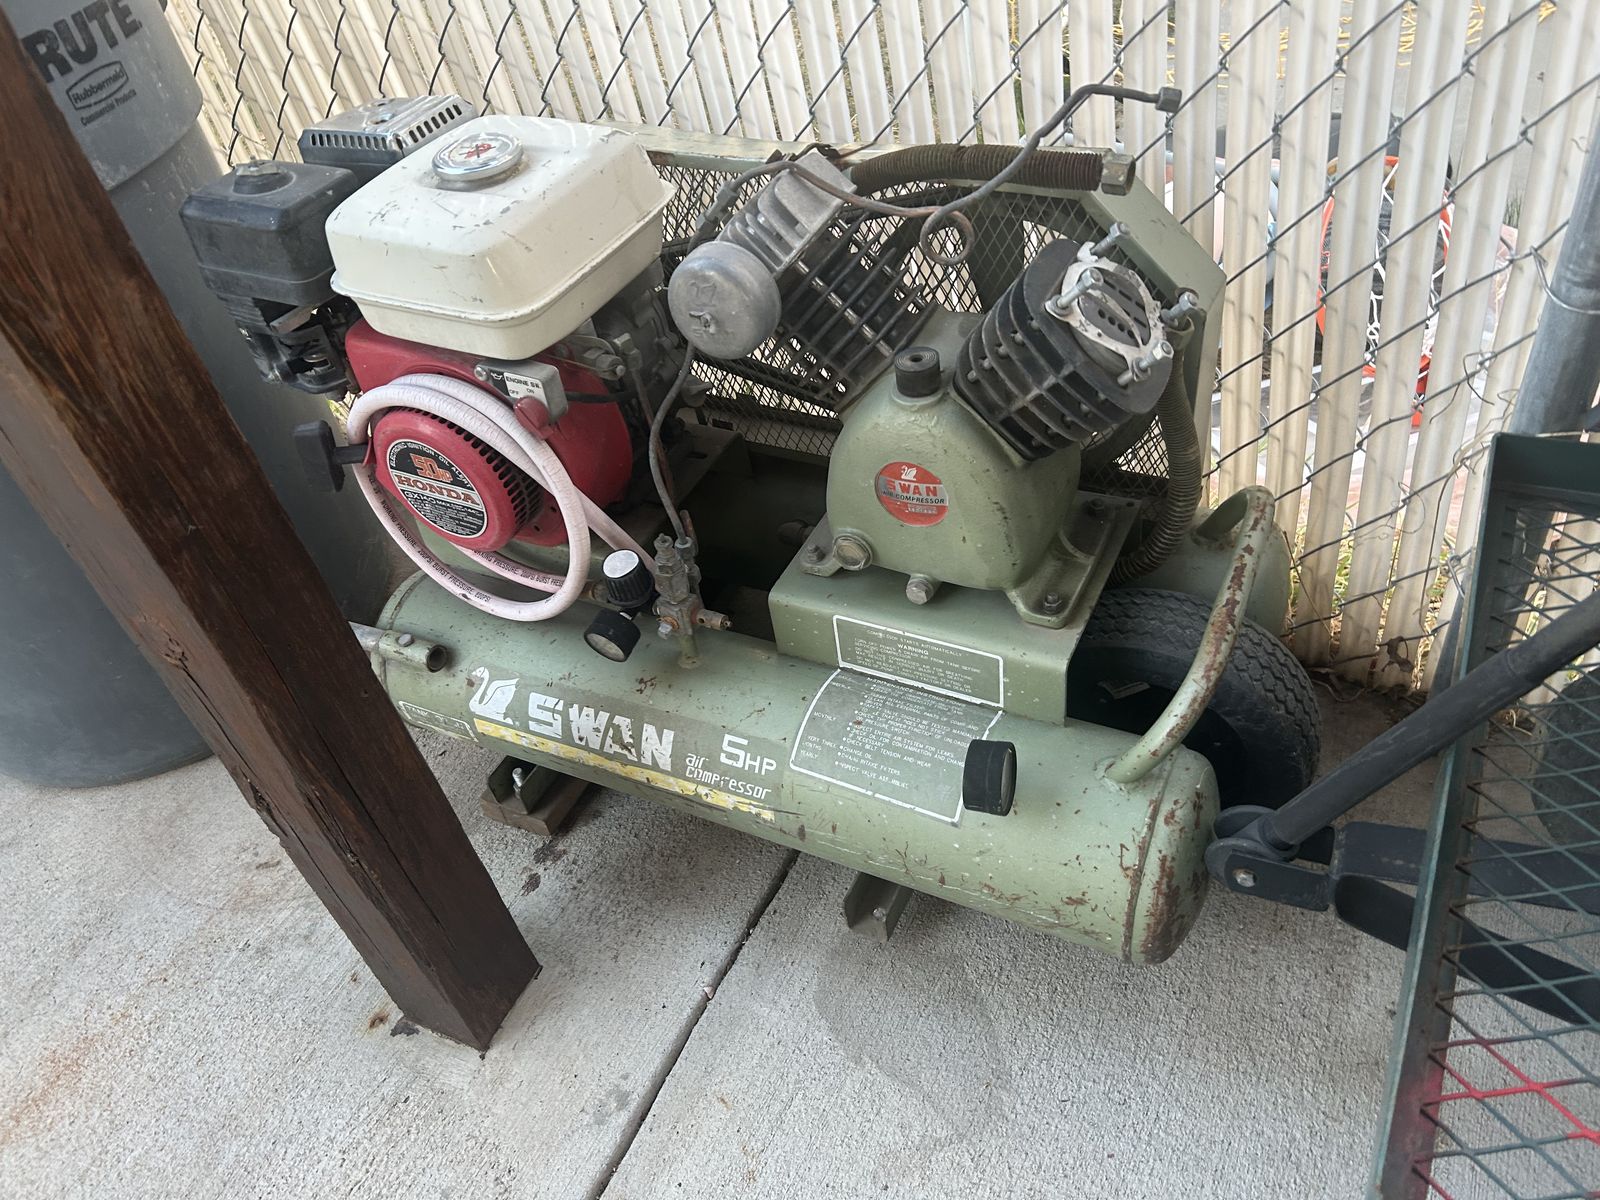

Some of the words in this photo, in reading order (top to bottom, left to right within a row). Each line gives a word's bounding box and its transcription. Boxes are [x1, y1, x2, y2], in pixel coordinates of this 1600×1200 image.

[22, 0, 140, 83] RUTE
[72, 68, 125, 104] Rubbermaid
[81, 102, 115, 126] Commercial
[115, 90, 137, 108] Products
[505, 375, 529, 388] ENGINE
[526, 387, 535, 395] ON
[390, 443, 407, 467] ELECTRONIC
[407, 442, 435, 456] IGNITION
[439, 455, 450, 466] OIL
[451, 467, 471, 488] ALERT
[395, 474, 480, 506] HONDA
[405, 491, 436, 504] GX140
[885, 479, 938, 497] SWAN
[896, 494, 945, 504] COMPRESSOR
[381, 500, 398, 522] WORKING
[418, 549, 434, 565] 200PSI
[432, 563, 448, 577] BURST
[896, 642, 928, 655] WARNING
[920, 642, 961, 657] AUTOMATICALLY
[812, 711, 836, 721] MONTHLY
[528, 692, 675, 771] SWAN
[720, 734, 777, 776] 5HP
[798, 748, 818, 759] YEARLY
[863, 743, 878, 751] BELT
[879, 748, 901, 759] TENSION
[902, 755, 915, 763] AND
[915, 759, 932, 769] WEAR
[890, 740, 933, 756] CONTAMINATION
[933, 753, 946, 761] AND
[924, 744, 936, 752] FOR
[685, 753, 710, 768] air
[685, 766, 772, 799] compressor
